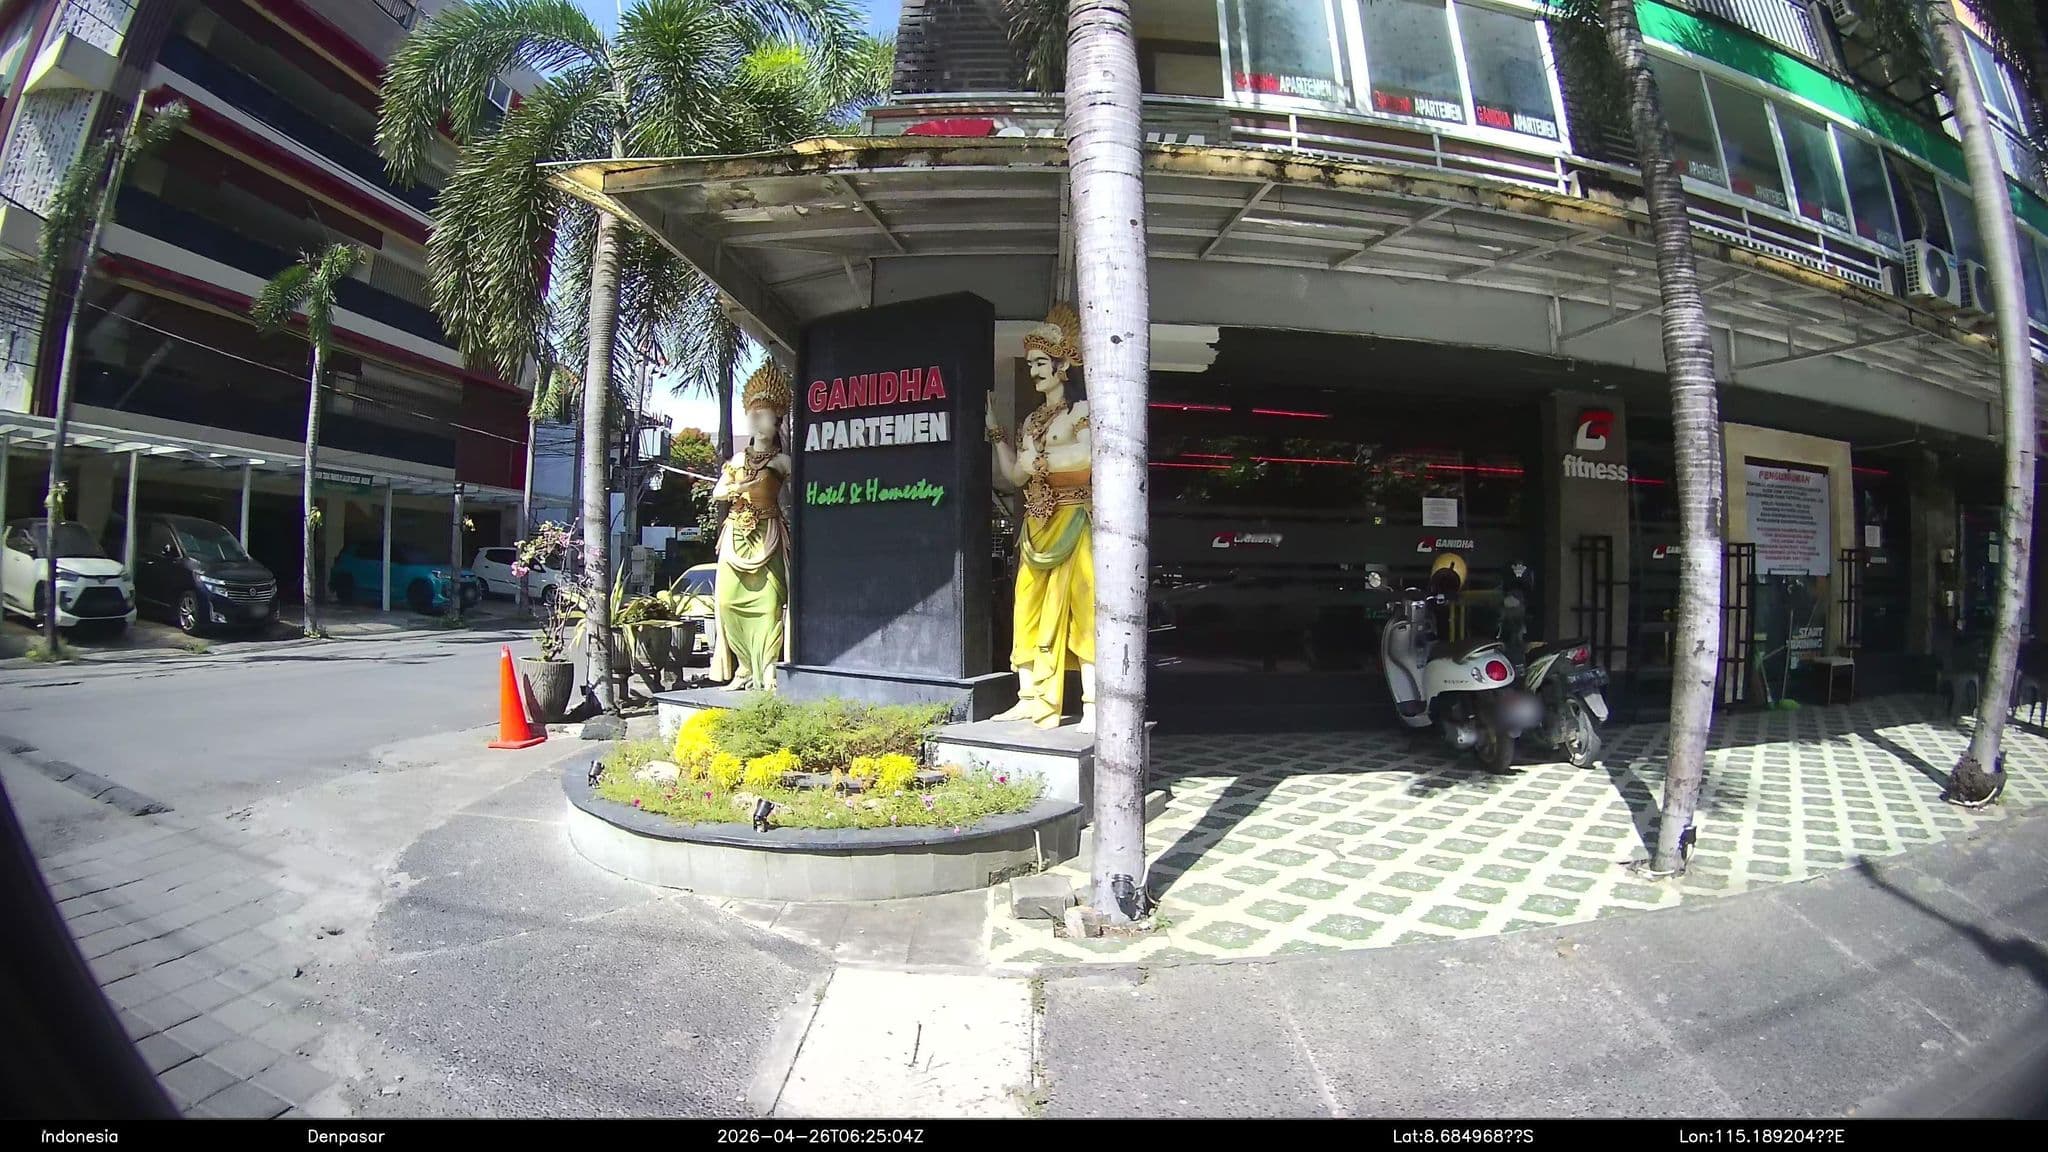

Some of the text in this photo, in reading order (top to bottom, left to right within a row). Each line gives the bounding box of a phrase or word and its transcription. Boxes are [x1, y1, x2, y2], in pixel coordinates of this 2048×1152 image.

[808, 366, 946, 413] GANIDHA
[804, 411, 950, 451] APARTEMEN
[1563, 454, 1629, 482] fitness
[806, 481, 846, 505] Hotel
[850, 482, 863, 504] &
[1435, 538, 1474, 549] GANIDHA
